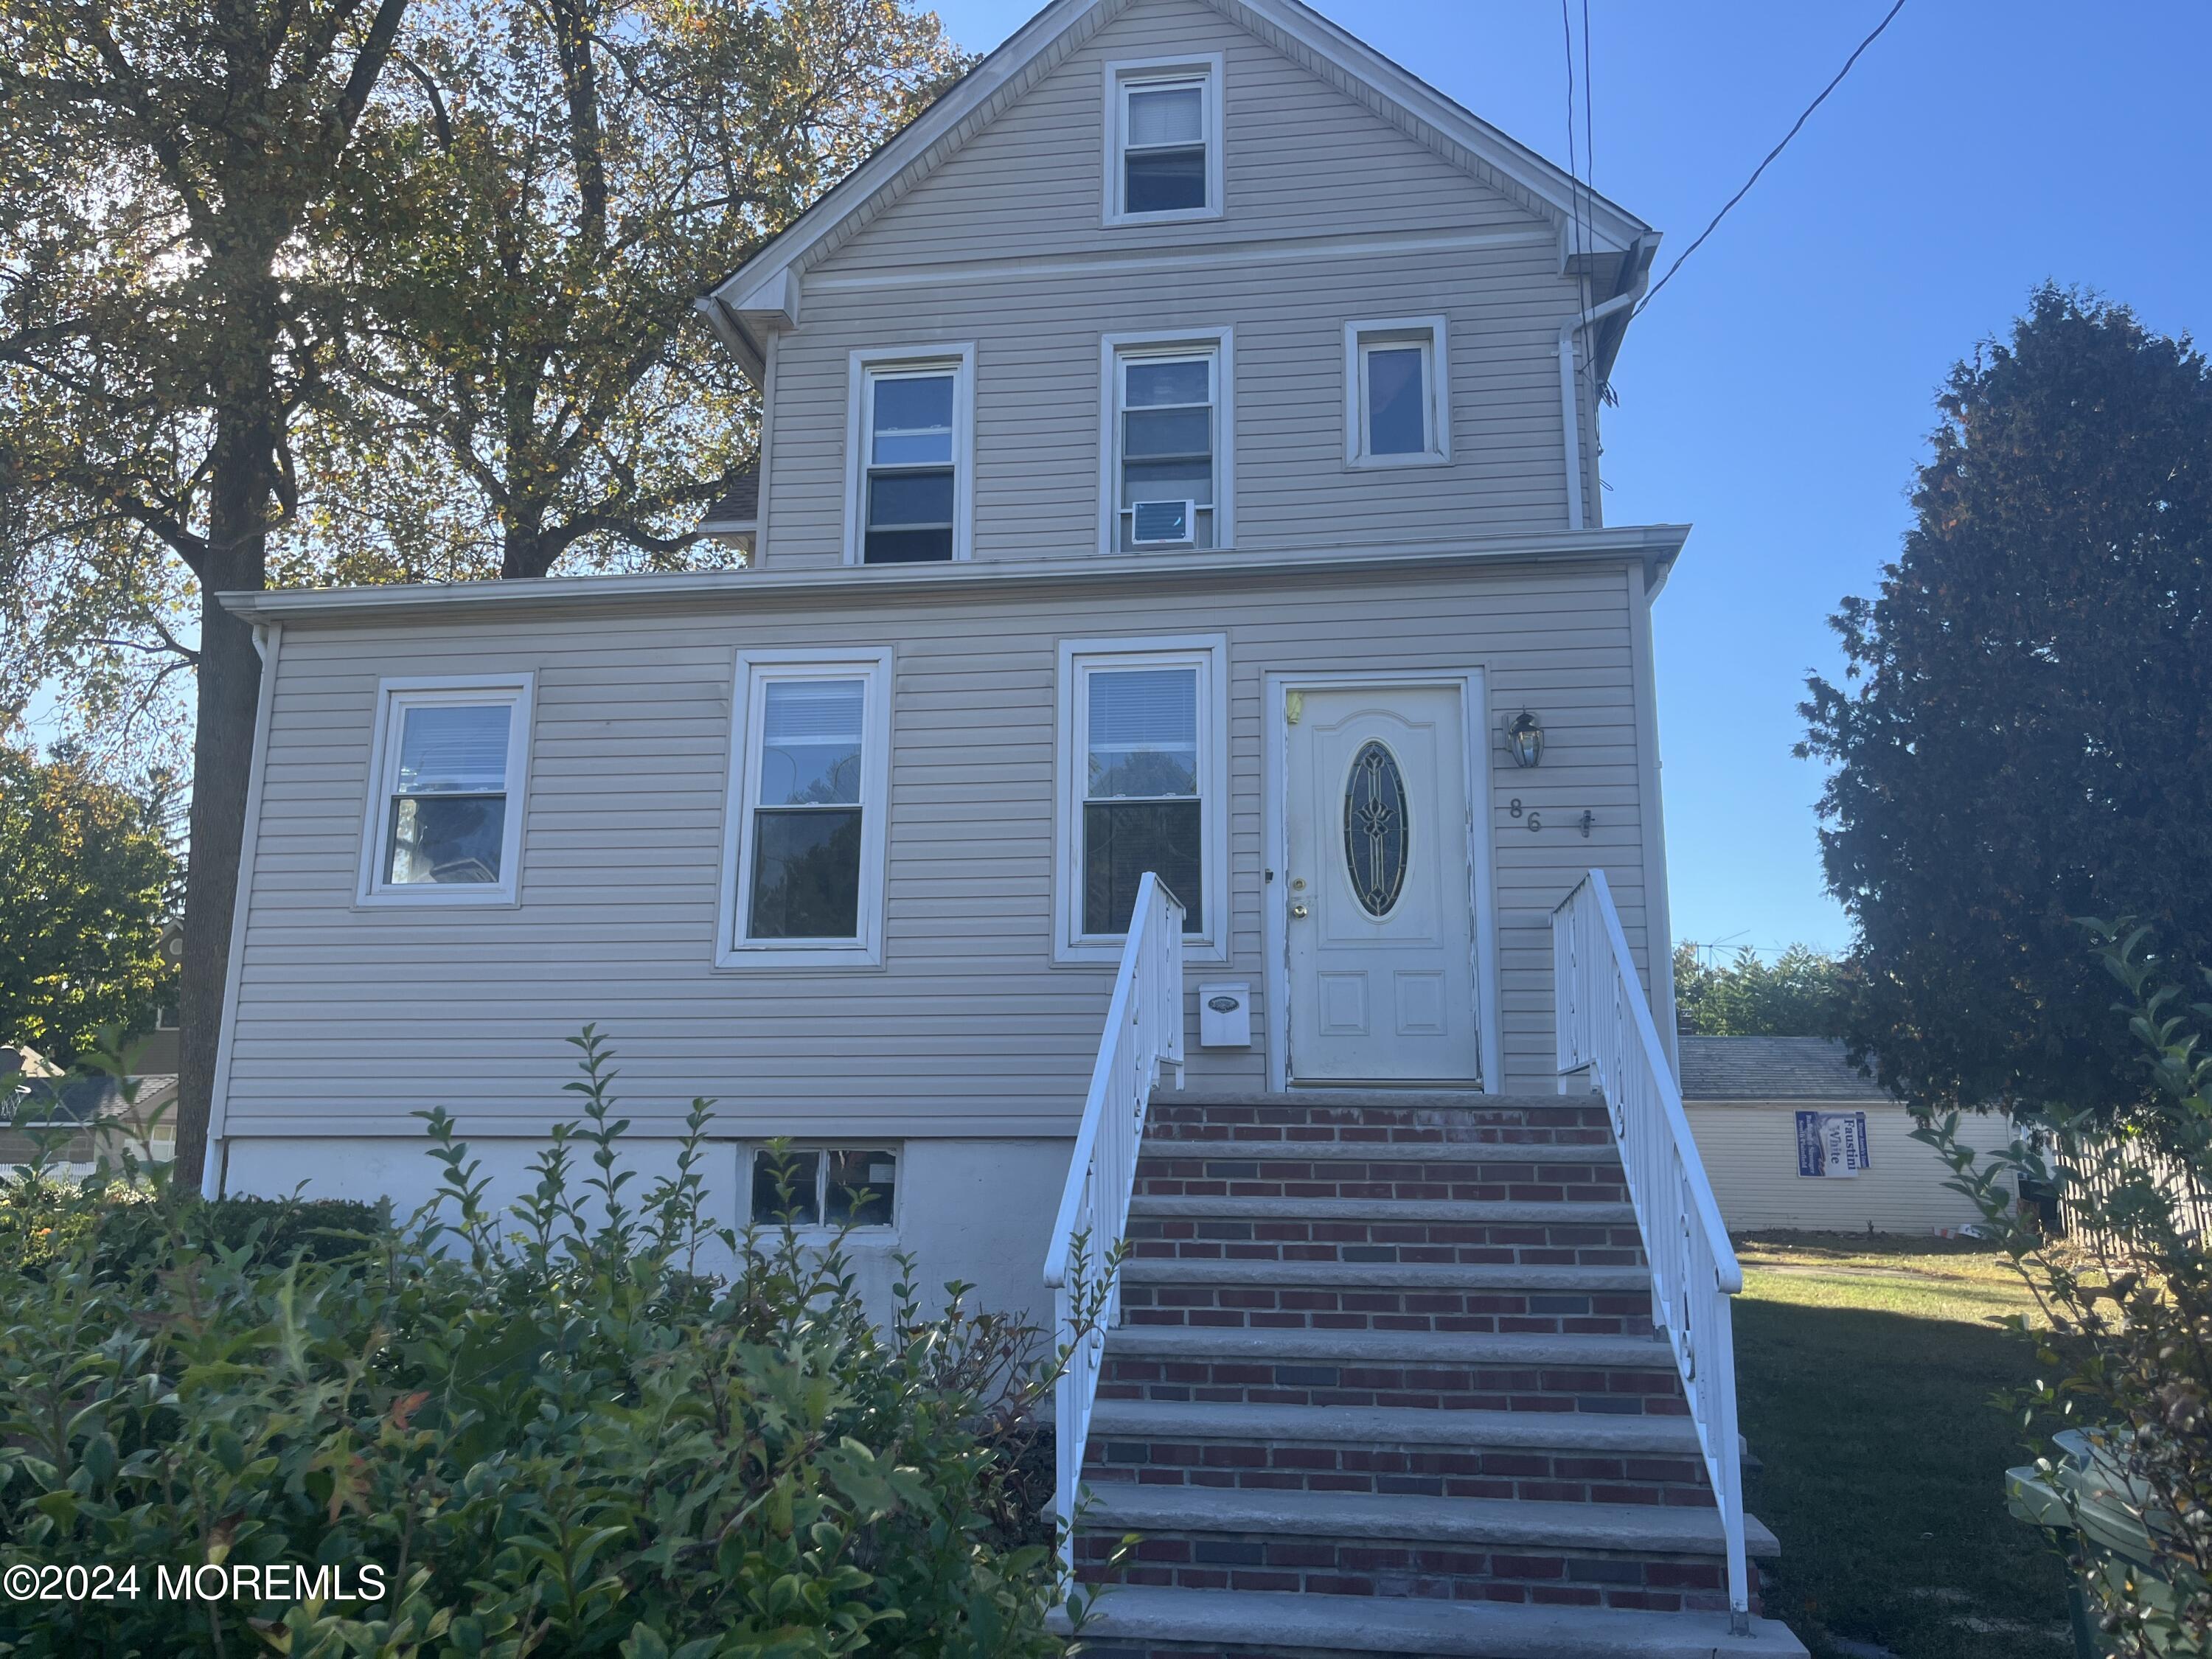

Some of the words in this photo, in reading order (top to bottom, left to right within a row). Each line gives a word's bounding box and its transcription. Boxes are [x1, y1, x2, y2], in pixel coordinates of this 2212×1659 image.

[1510, 798, 1541, 832] 86
[1800, 1138, 1808, 1168] Plainfield
[1829, 1125, 1841, 1164] White
